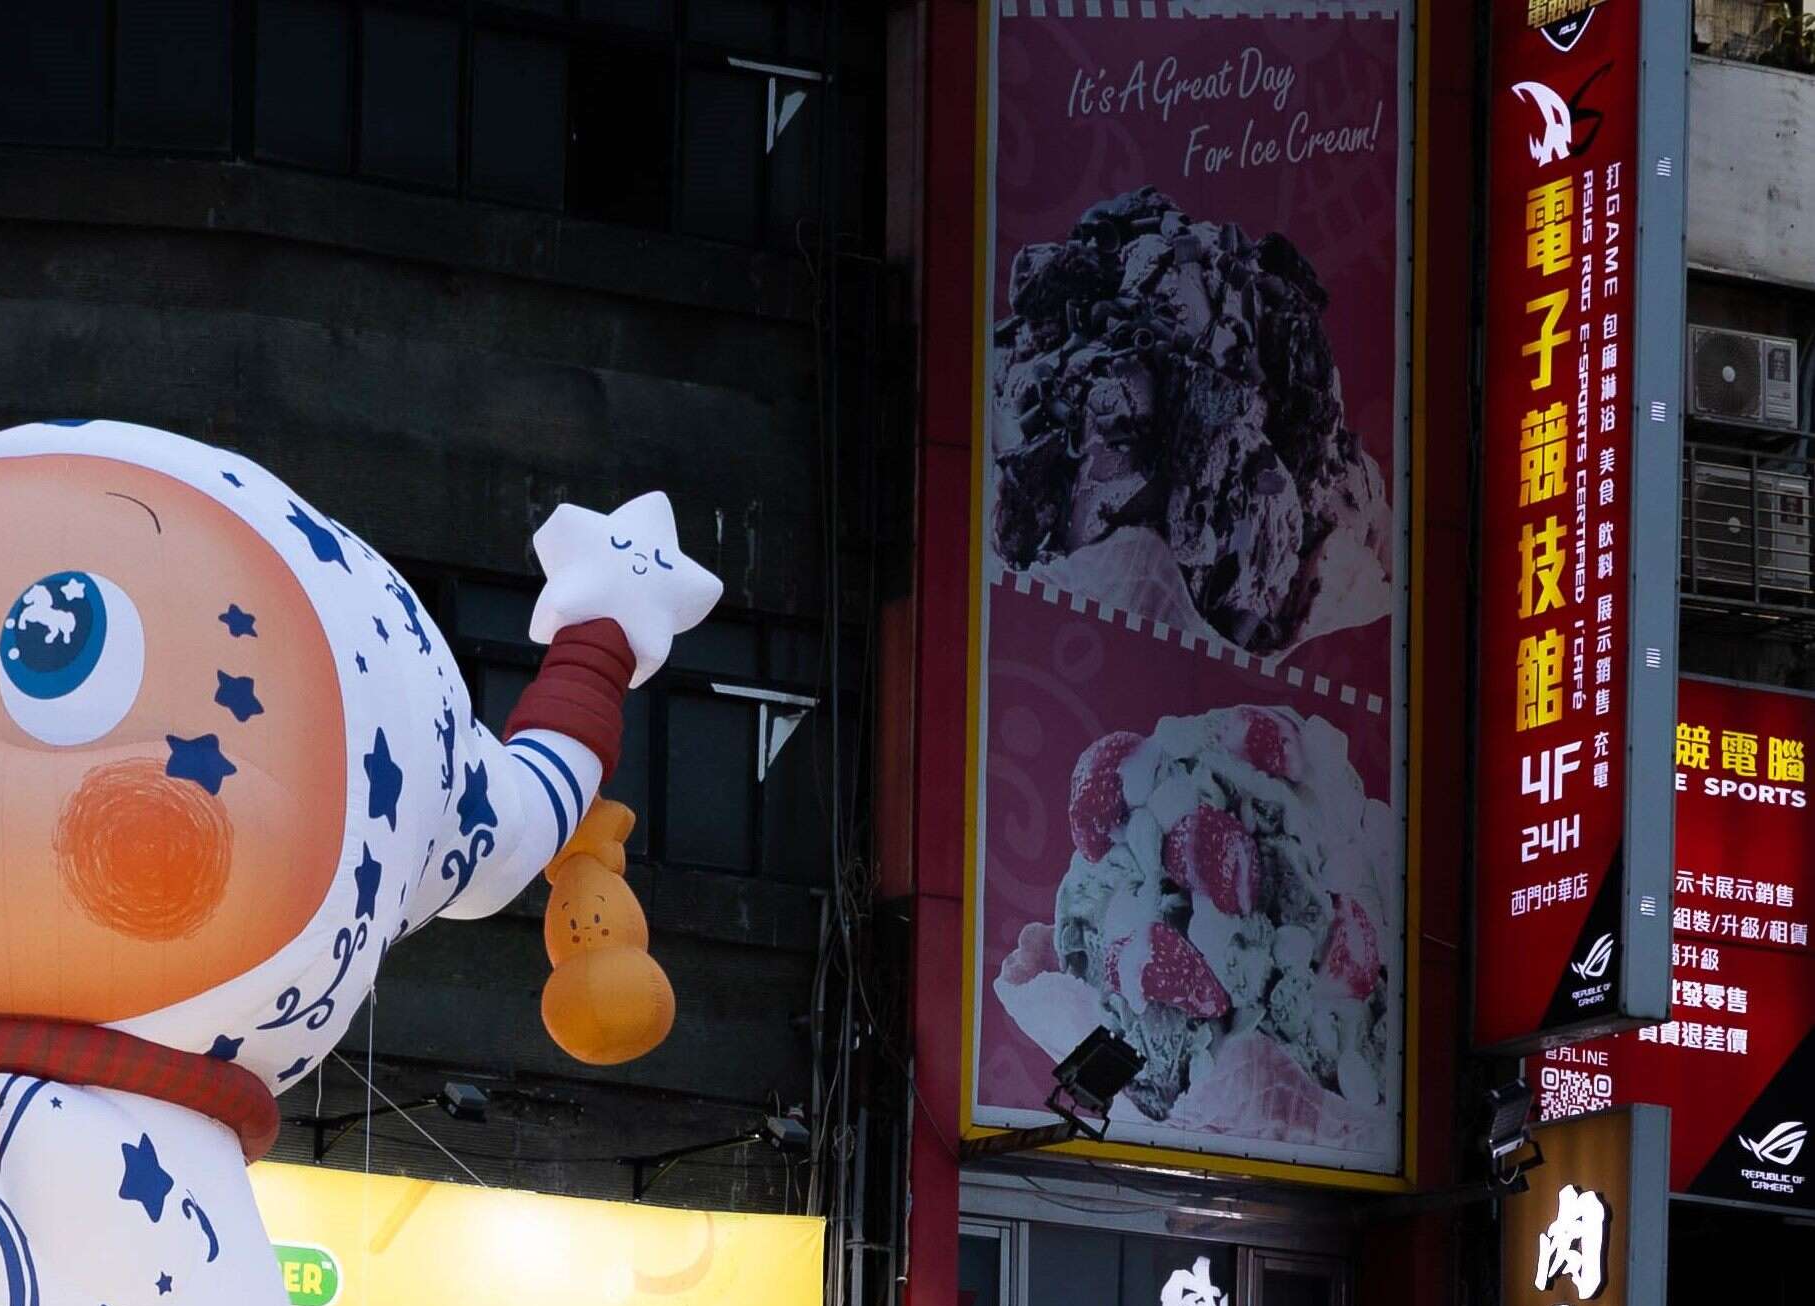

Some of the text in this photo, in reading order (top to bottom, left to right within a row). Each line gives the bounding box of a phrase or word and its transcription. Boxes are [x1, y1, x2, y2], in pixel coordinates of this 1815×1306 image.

[1067, 47, 1295, 122] It's A Great Day
[1183, 101, 1383, 178] For Ice Cream!
[1581, 169, 1594, 245] ASUS
[1579, 253, 1593, 313] ROG
[1515, 175, 1574, 733] 電子競技館
[1598, 447, 1616, 506] 美食
[1597, 520, 1614, 580] 飲料
[1594, 594, 1613, 717] 展示銷售
[1521, 740, 1583, 805] 4F
[1593, 731, 1609, 788] 充電
[1674, 722, 1805, 784] 競電腦
[1704, 777, 1807, 808] SPORTS
[1521, 813, 1581, 863] 24H
[1511, 872, 1589, 917] 西門中華店
[1741, 1168, 1806, 1185] REPUBLIC OF
[1751, 1180, 1795, 1194] GAMERS
